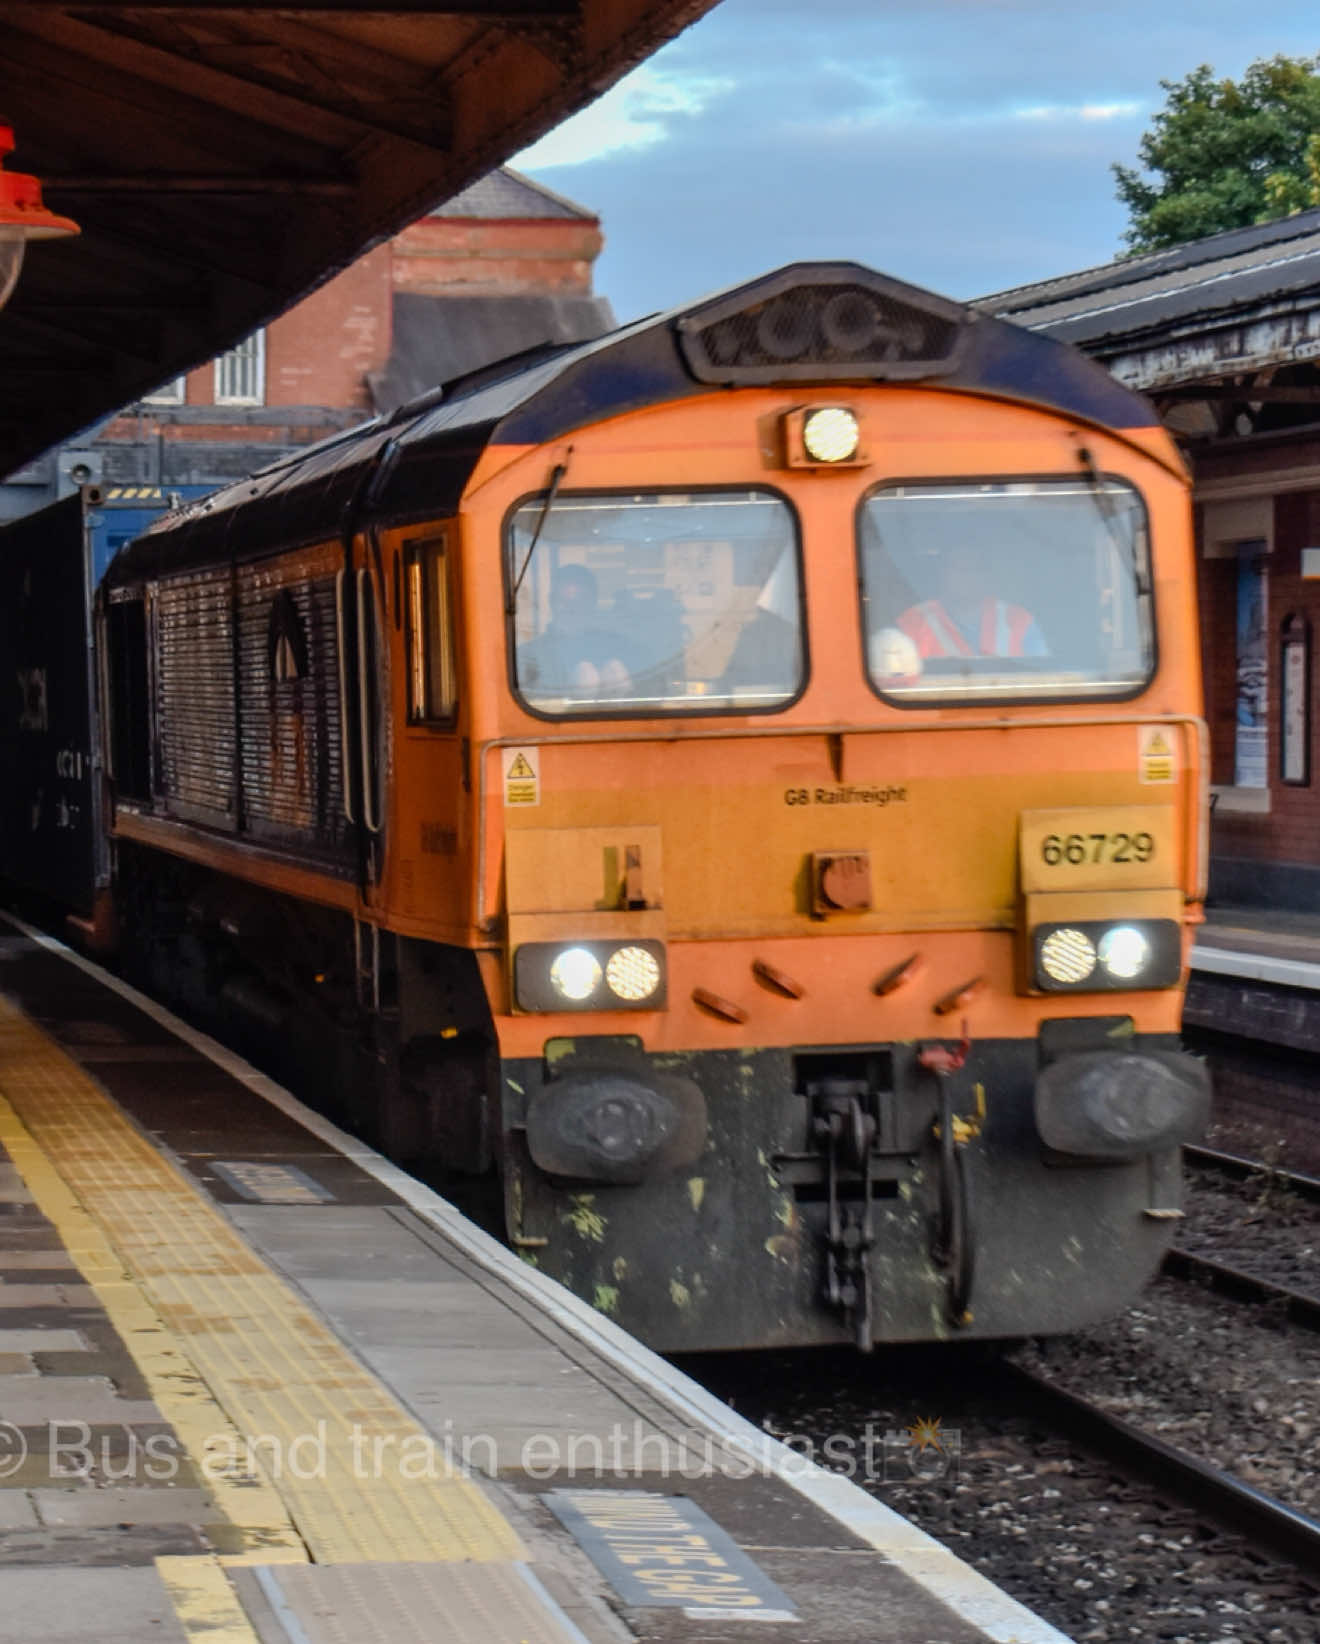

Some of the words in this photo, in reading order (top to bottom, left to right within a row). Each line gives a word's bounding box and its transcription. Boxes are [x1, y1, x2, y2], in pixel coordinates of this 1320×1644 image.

[784, 788, 810, 806] GB
[814, 785, 907, 807] Railfreight
[1040, 832, 1155, 866] 66729
[603, 1533, 729, 1567] THE
[632, 1569, 763, 1606] GAP
